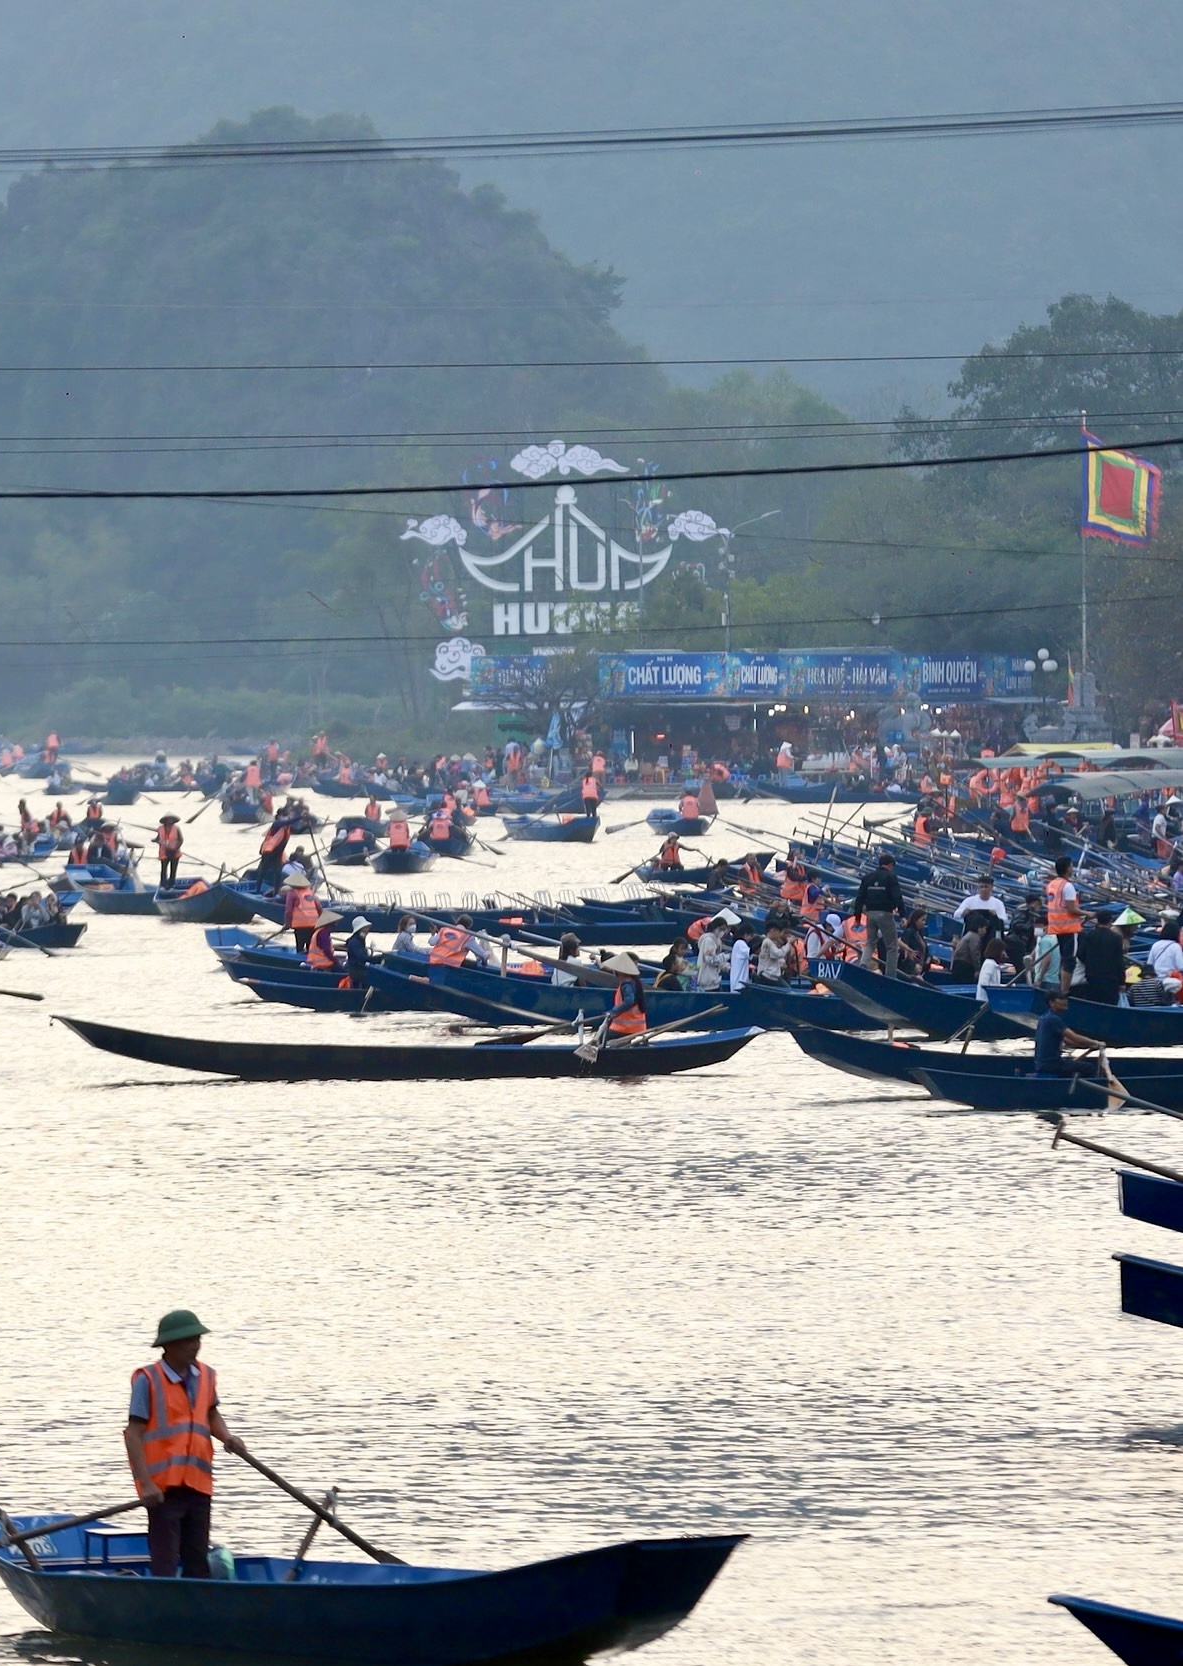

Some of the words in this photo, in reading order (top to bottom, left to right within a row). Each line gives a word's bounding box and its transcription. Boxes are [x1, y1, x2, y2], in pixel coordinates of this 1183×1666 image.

[628, 659, 660, 685] CHẤT
[662, 663, 701, 689] LƯỢNG
[741, 659, 757, 684] CHẤT
[922, 656, 944, 683] BÌNH
[946, 656, 977, 686] QUYÊN
